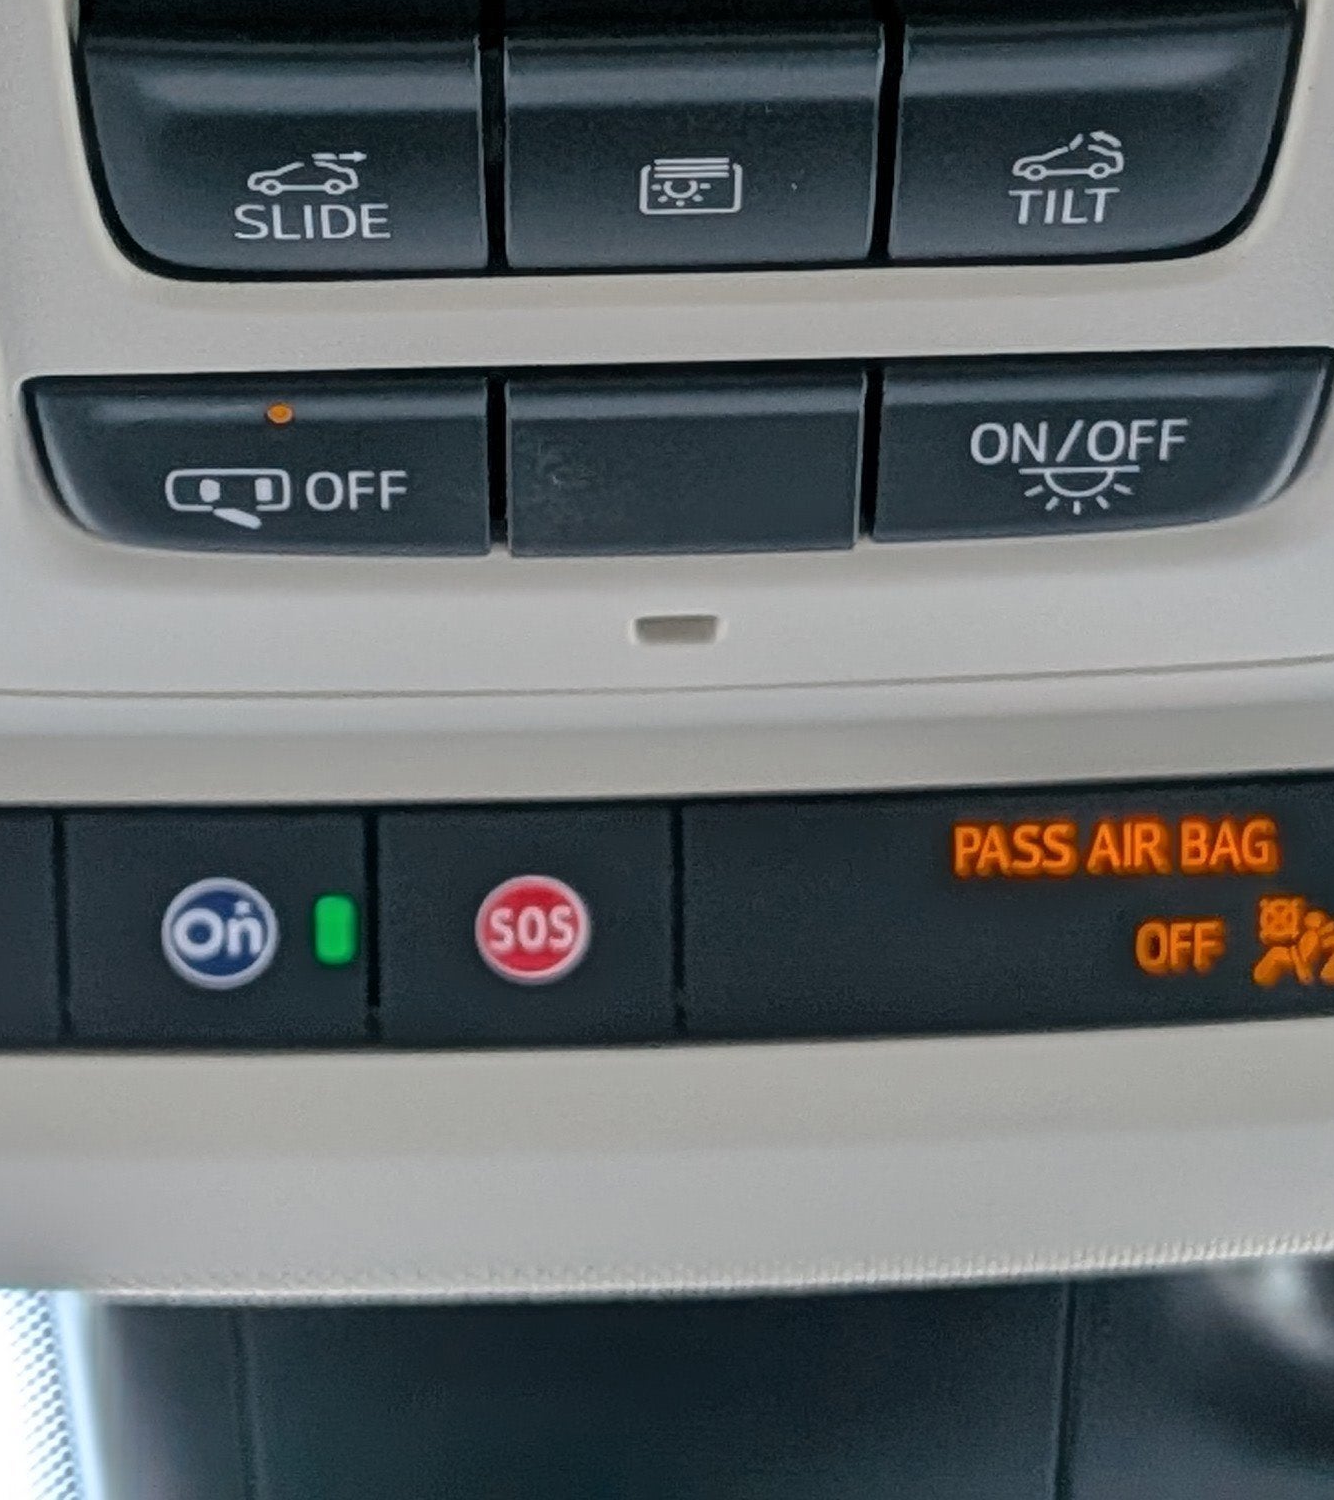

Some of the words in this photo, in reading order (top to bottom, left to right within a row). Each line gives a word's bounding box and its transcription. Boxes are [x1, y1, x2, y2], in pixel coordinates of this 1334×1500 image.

[234, 203, 391, 240] SLIDE
[1008, 187, 1119, 224] TILT
[969, 417, 1189, 467] ON/OFF
[304, 469, 407, 511] OFF
[954, 818, 1076, 877] PASS
[1087, 816, 1168, 875] AIR
[1180, 814, 1280, 875] BAG
[488, 903, 576, 954] SOS
[1134, 916, 1227, 976] OFF
